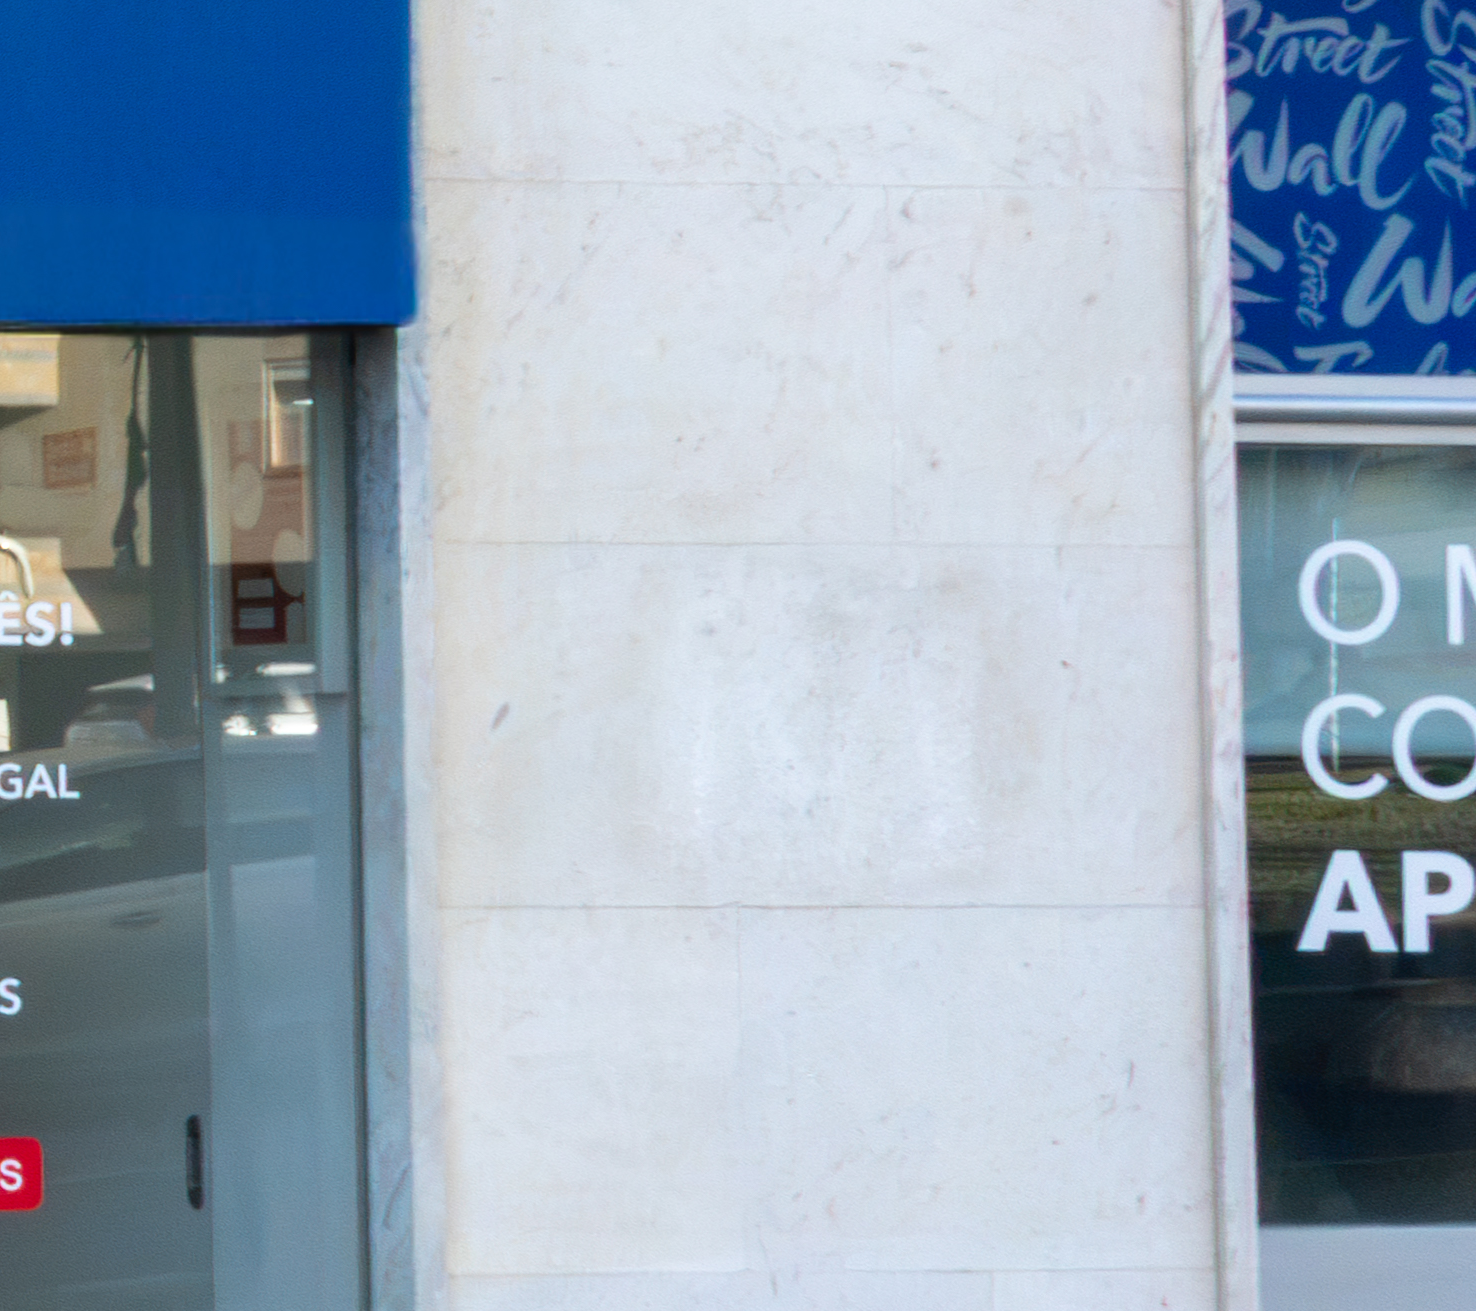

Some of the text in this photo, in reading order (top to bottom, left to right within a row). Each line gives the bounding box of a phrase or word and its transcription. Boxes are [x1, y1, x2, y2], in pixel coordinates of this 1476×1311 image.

[1297, 539, 1401, 645] O
[1301, 693, 1476, 801] CO
[1296, 849, 1475, 953] AP
